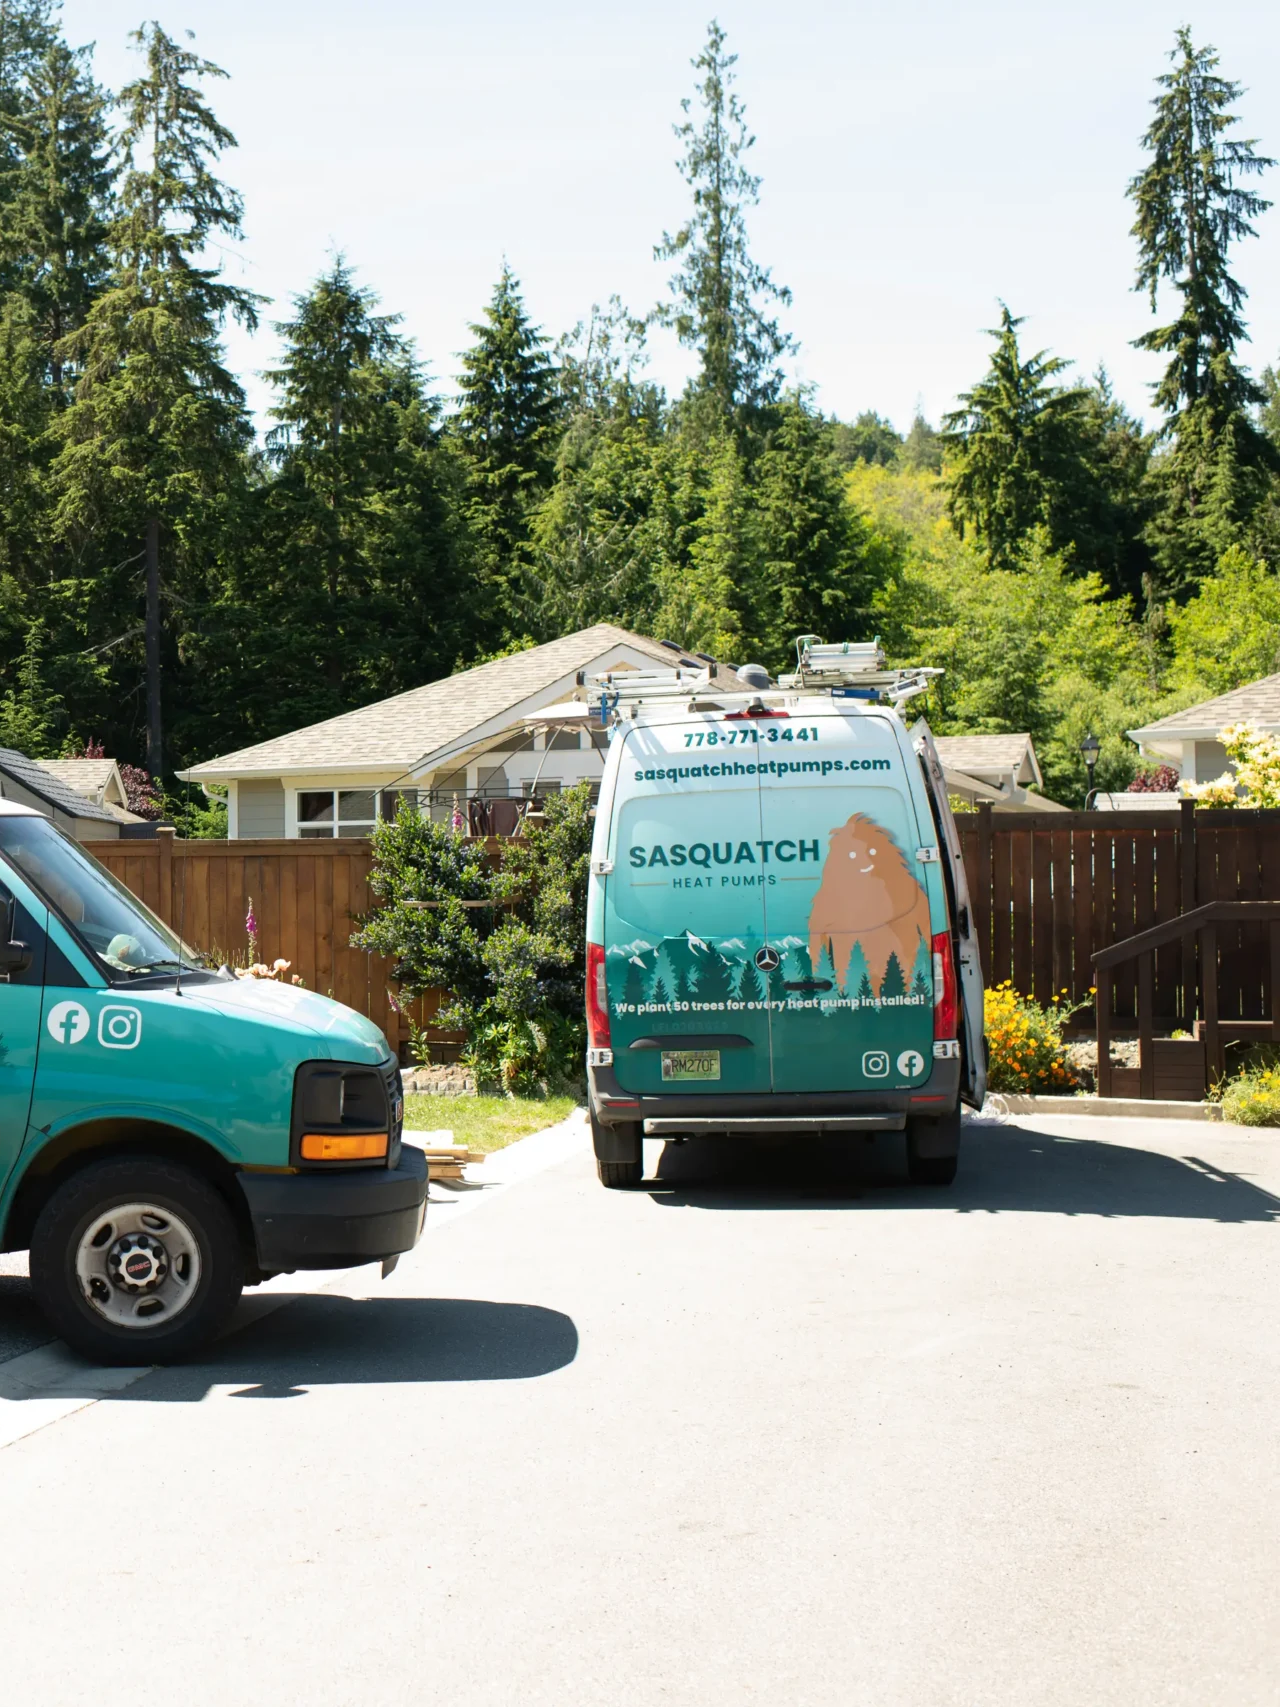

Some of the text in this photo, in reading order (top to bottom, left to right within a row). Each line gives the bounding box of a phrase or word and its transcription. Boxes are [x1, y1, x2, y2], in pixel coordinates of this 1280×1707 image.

[634, 757, 891, 783] sasquatchheatpumps.com
[629, 839, 820, 868] SASQUATCH
[672, 874, 777, 888] HEAT PUMPS
[615, 994, 925, 1015] We plant 50 trees for every heat pump installed!
